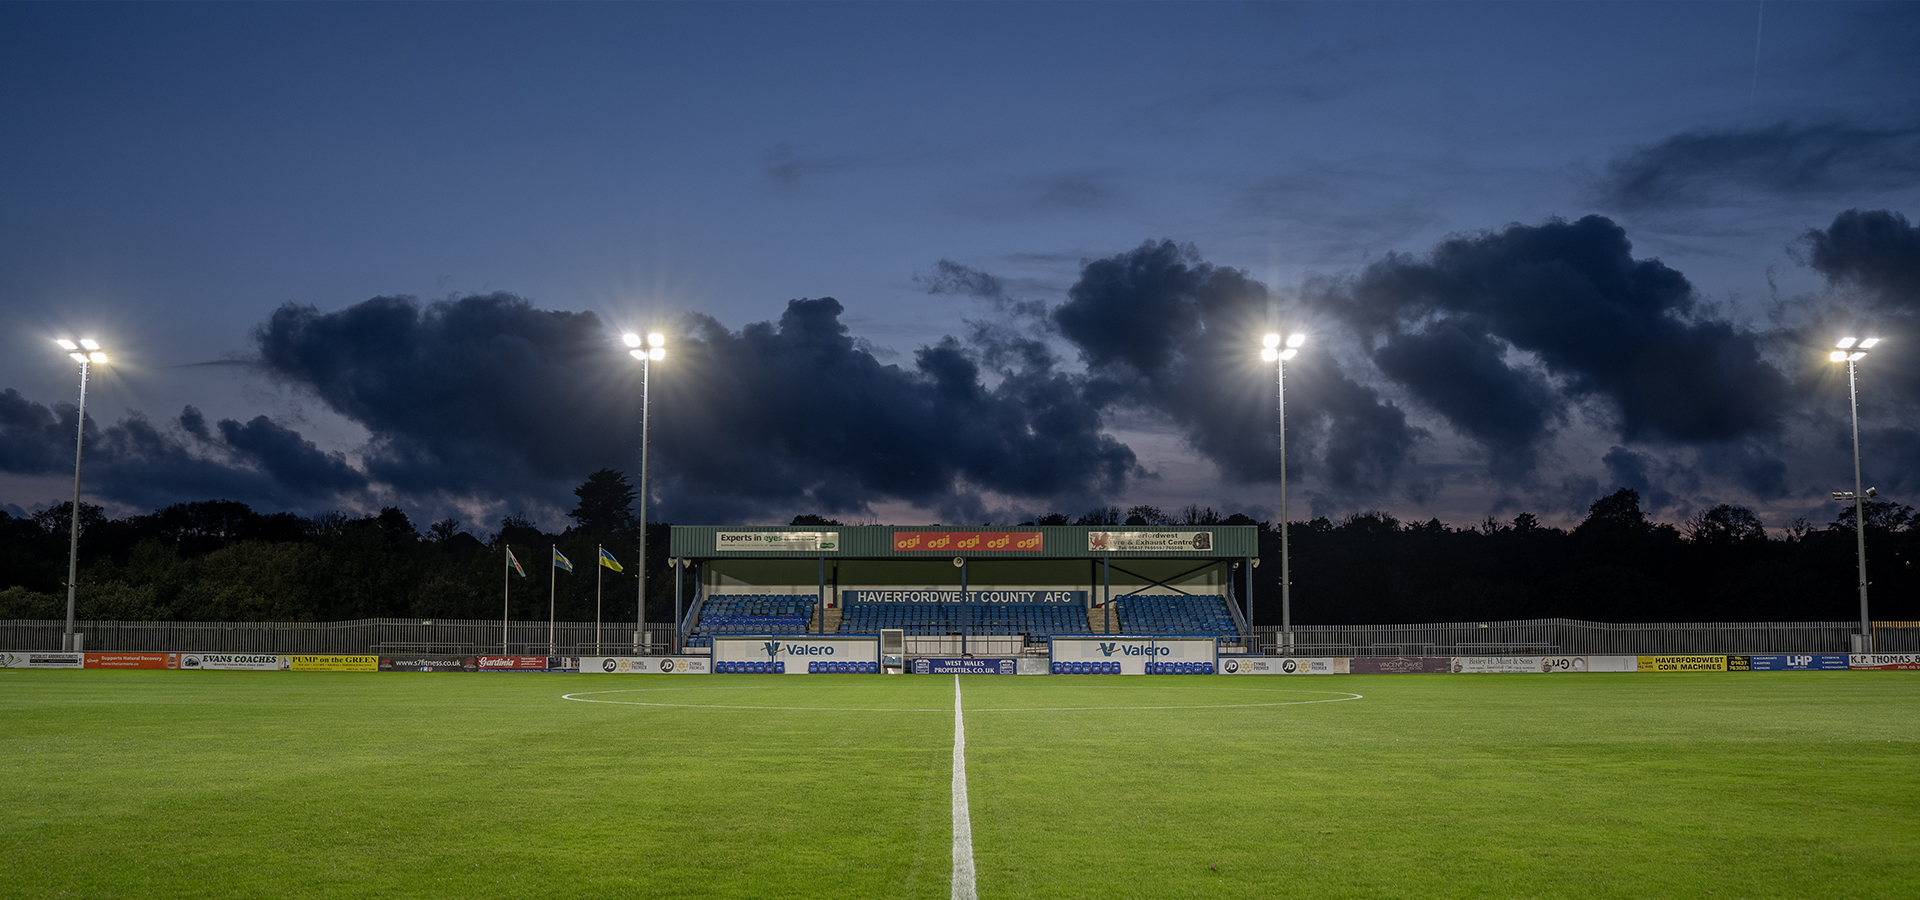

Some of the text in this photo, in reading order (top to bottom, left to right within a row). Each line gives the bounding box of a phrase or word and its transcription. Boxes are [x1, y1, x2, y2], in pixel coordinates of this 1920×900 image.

[721, 534, 752, 543] Experts
[764, 535, 782, 543] eyes
[898, 534, 920, 548] ogi
[927, 534, 950, 548] ogi
[957, 534, 980, 548] ogi
[987, 534, 1010, 548] ogi
[1016, 534, 1040, 548] ogi
[980, 592, 1036, 602] COUNTY
[1044, 592, 1071, 602] AFC
[786, 644, 834, 656] Valero
[1122, 644, 1170, 656] Valero
[396, 658, 461, 666] www.s7fitness.co.uk
[478, 657, 514, 668] Gardinia
[1786, 655, 1812, 666] LHP
